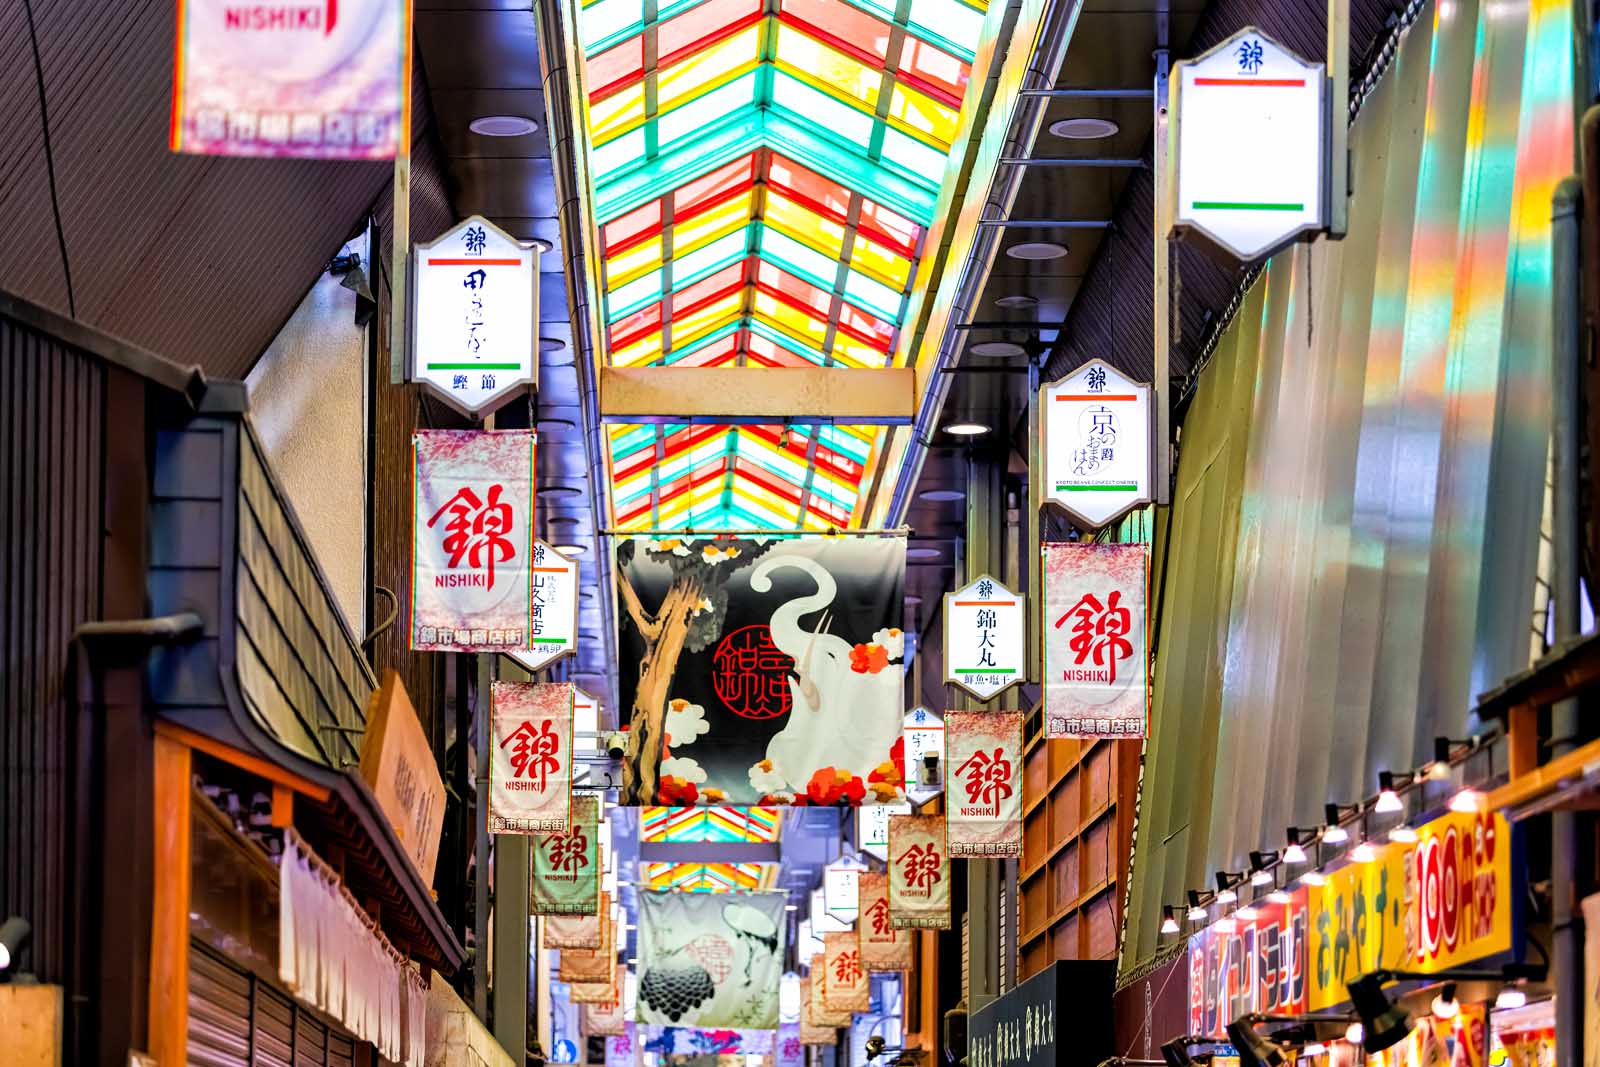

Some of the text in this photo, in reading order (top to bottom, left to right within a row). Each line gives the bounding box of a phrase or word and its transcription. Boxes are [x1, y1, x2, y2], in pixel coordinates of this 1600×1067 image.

[224, 6, 321, 31] NISHIKI
[1234, 40, 1263, 75] 錦
[461, 226, 486, 256] 錦
[1084, 367, 1106, 392] 錦
[427, 484, 515, 592] 錦
[435, 573, 486, 588] NISHIKI
[976, 580, 993, 599] 錦
[419, 626, 523, 645] 錦市場商店街
[976, 608, 997, 667] 錦大丸
[1055, 590, 1134, 686] 錦
[1063, 669, 1109, 682] NISHIKI
[1051, 718, 1141, 735] 錦市場商店街
[500, 719, 560, 795] 錦
[505, 781, 541, 792] NISHIKI
[954, 747, 1013, 819] 錦
[960, 807, 995, 817] NISHIKI
[541, 825, 589, 884] 錦
[896, 842, 941, 899] 錦
